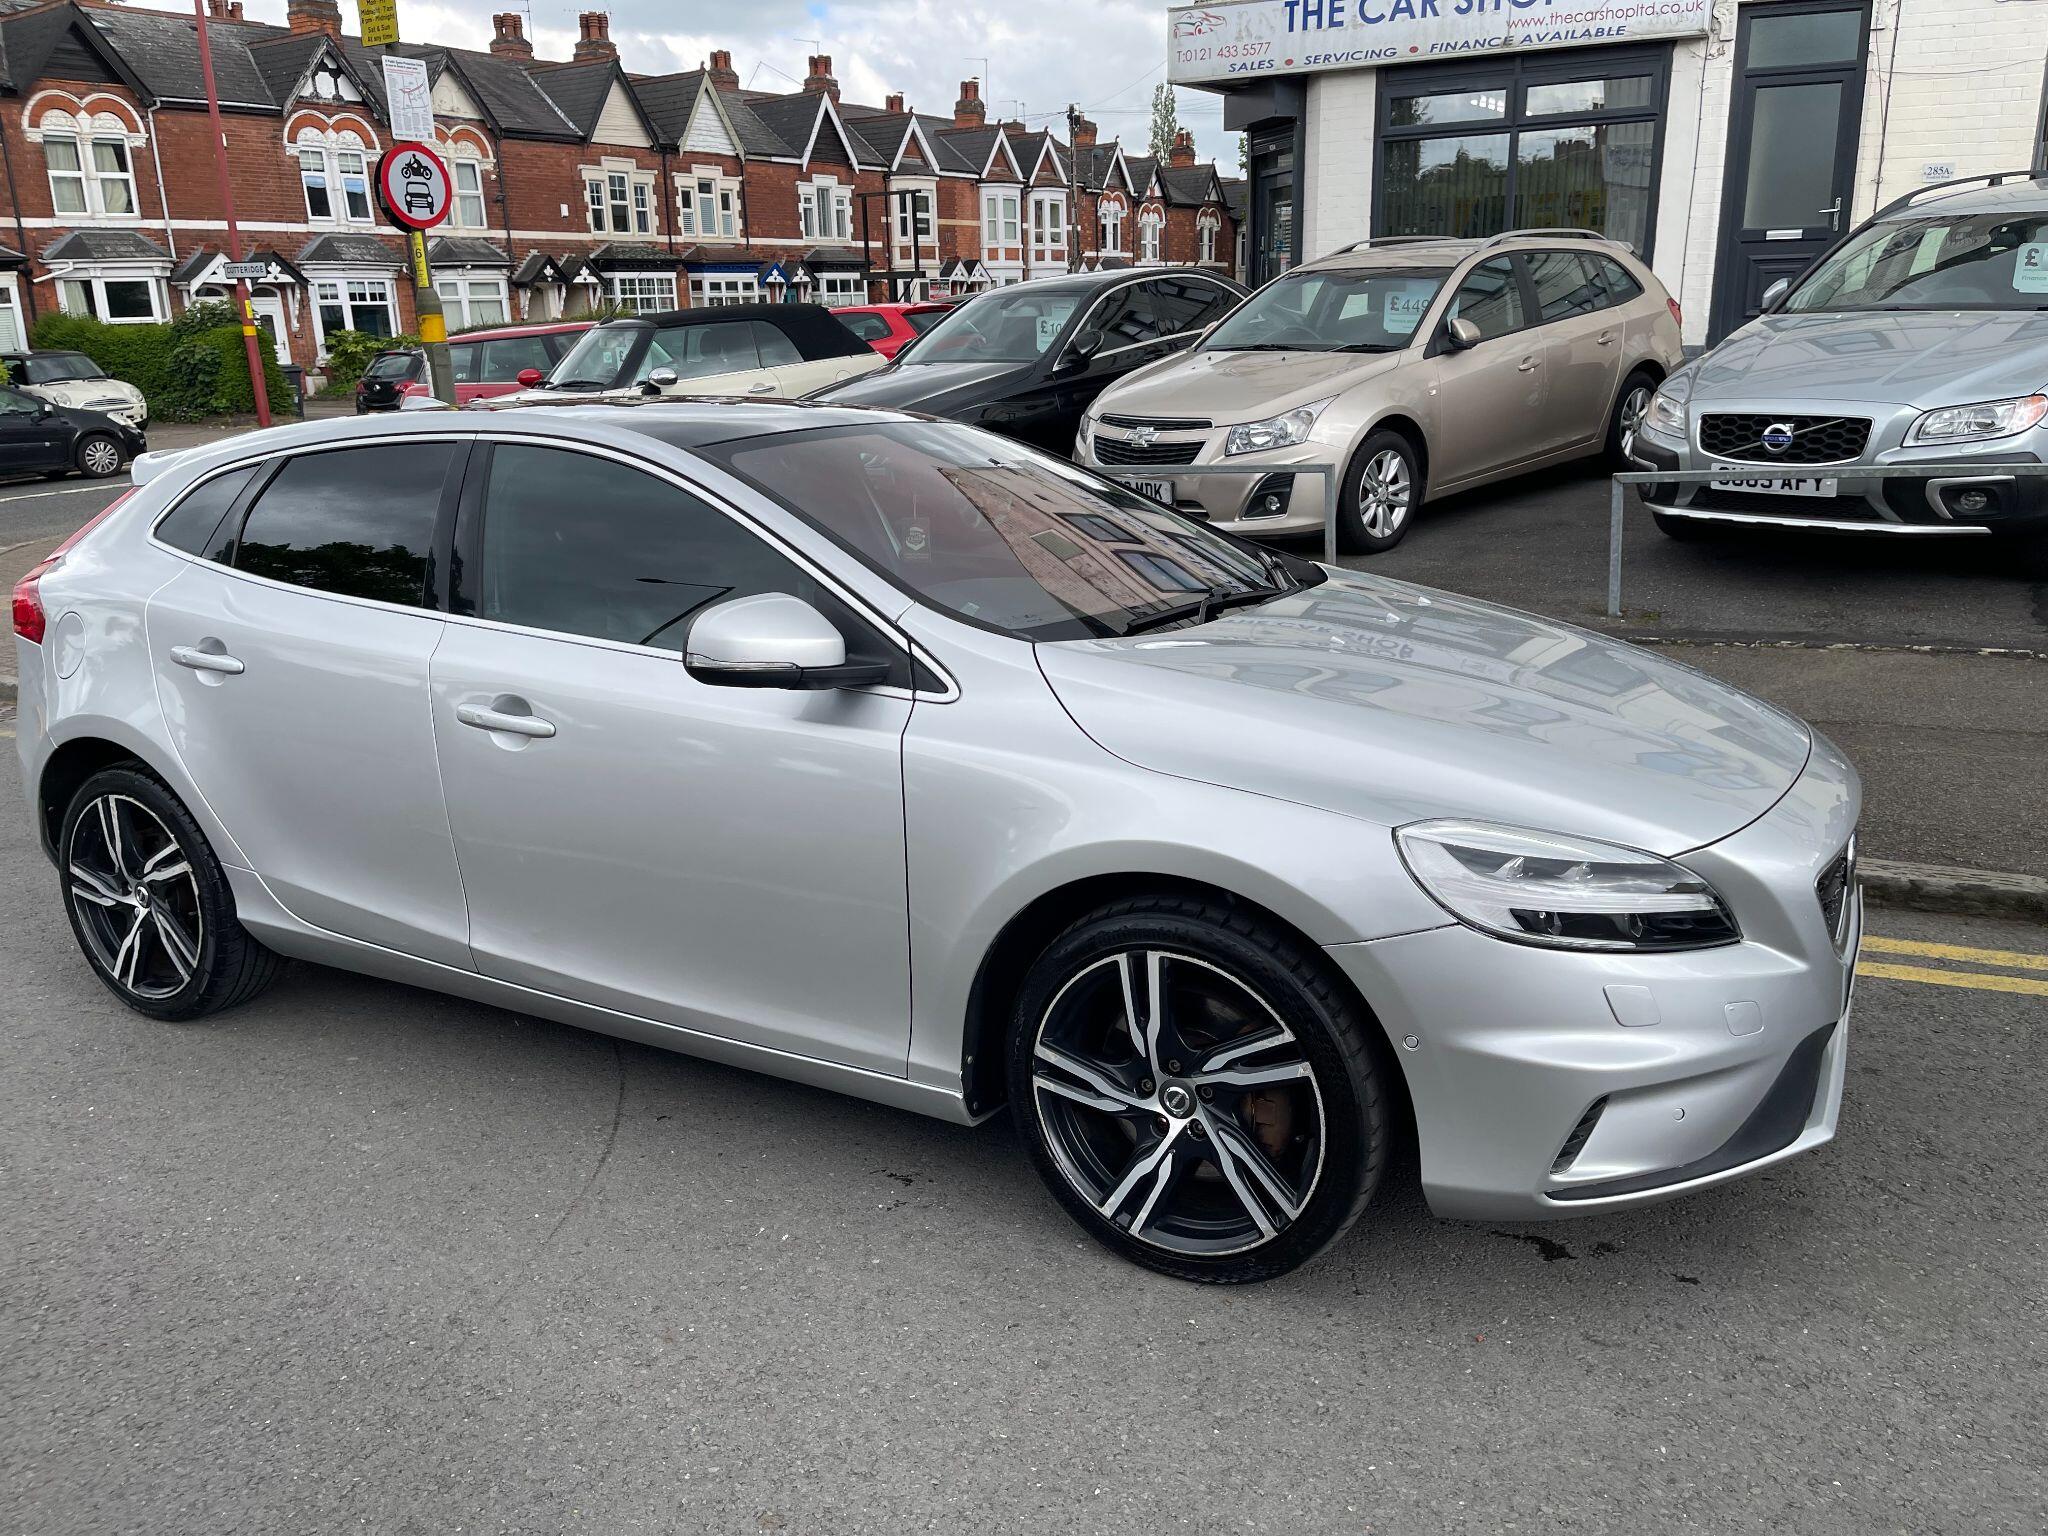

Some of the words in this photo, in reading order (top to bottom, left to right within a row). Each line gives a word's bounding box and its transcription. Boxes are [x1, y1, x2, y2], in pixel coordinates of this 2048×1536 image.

[1285, 0, 1345, 33] THE
[1358, 0, 1440, 25] CAR
[1506, 0, 1704, 29] www.thecarshopltd.co.uk
[1216, 45, 1238, 58] 433
[1242, 41, 1272, 57] 5577
[1429, 35, 1514, 53] FINANCE
[1519, 25, 1627, 44] AVAILABLE
[1228, 59, 1275, 73] SALES
[1303, 47, 1397, 65] SERVICING
[1927, 166, 1950, 176] 285A
[415, 248, 422, 258] 6
[226, 266, 264, 274] COTTERIDGE
